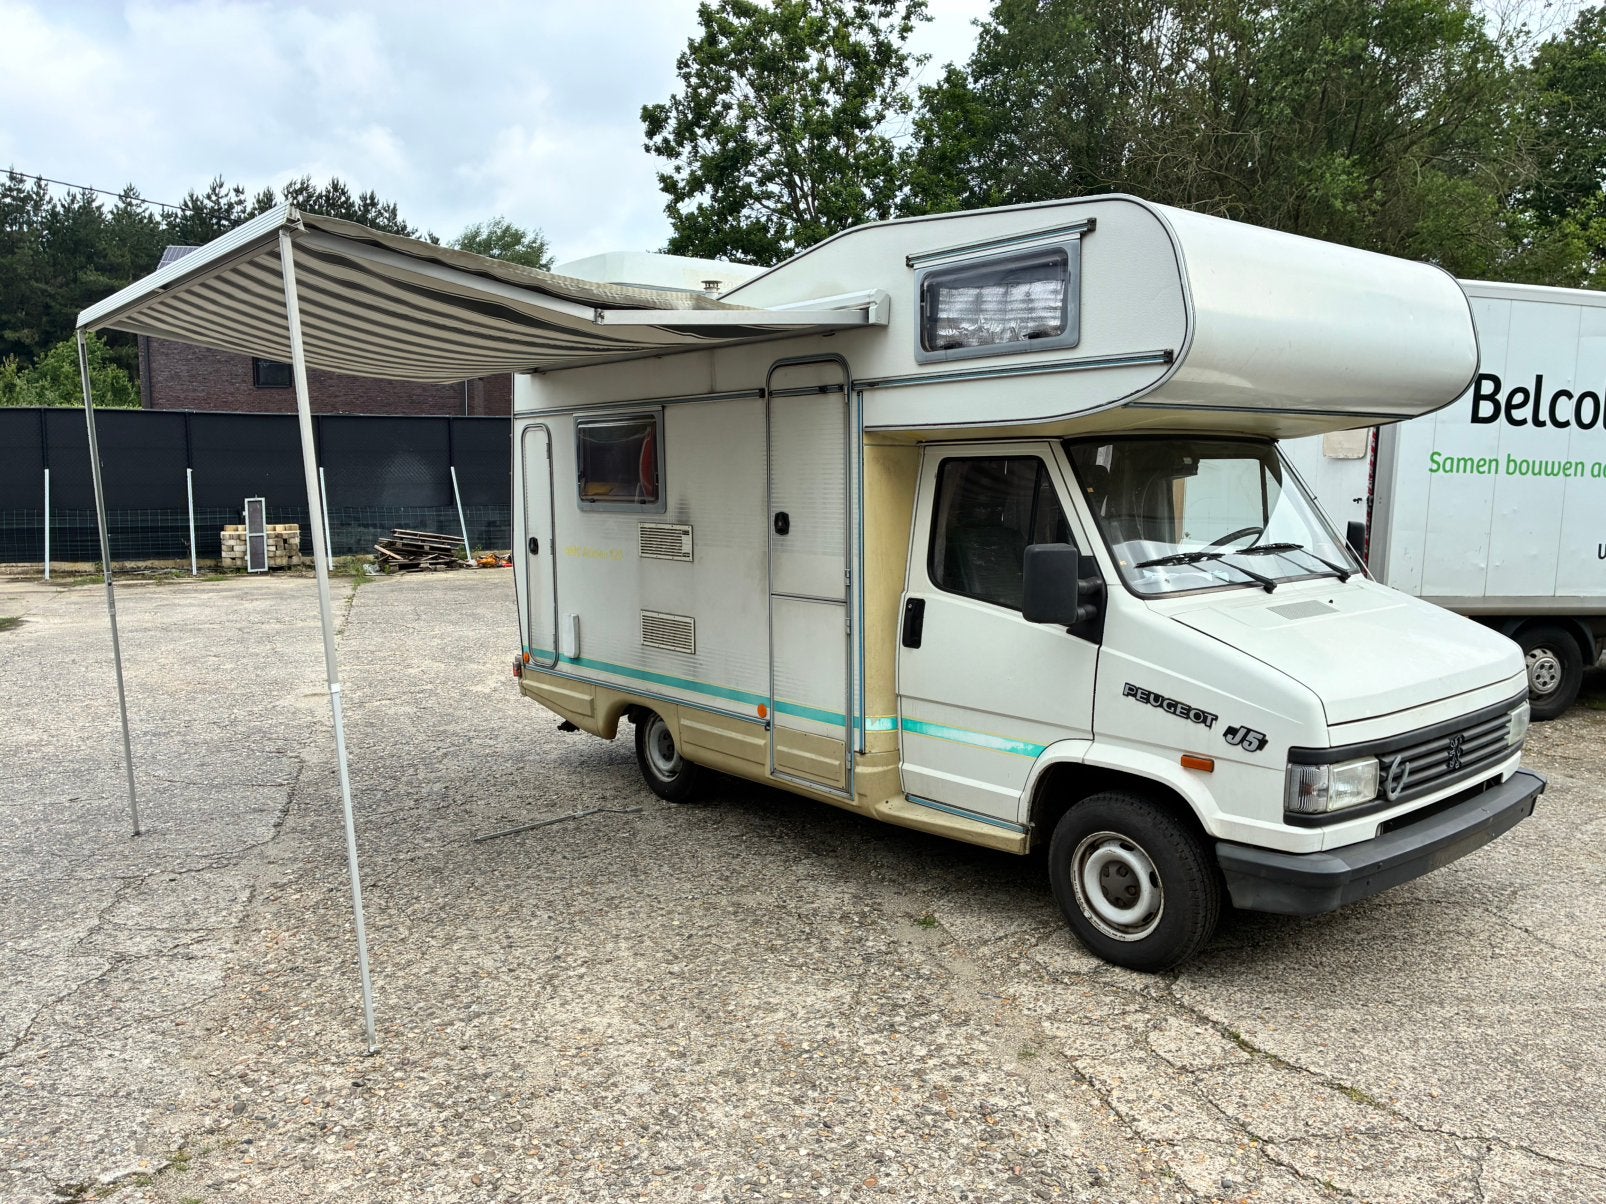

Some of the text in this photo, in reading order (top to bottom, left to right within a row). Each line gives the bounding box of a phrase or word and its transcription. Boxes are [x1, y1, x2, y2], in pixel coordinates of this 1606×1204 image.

[1471, 373, 1606, 430] Belco
[1428, 451, 1499, 475] Samen
[1505, 453, 1585, 478] bouwen
[1123, 682, 1267, 752] PEUGEOT J5
